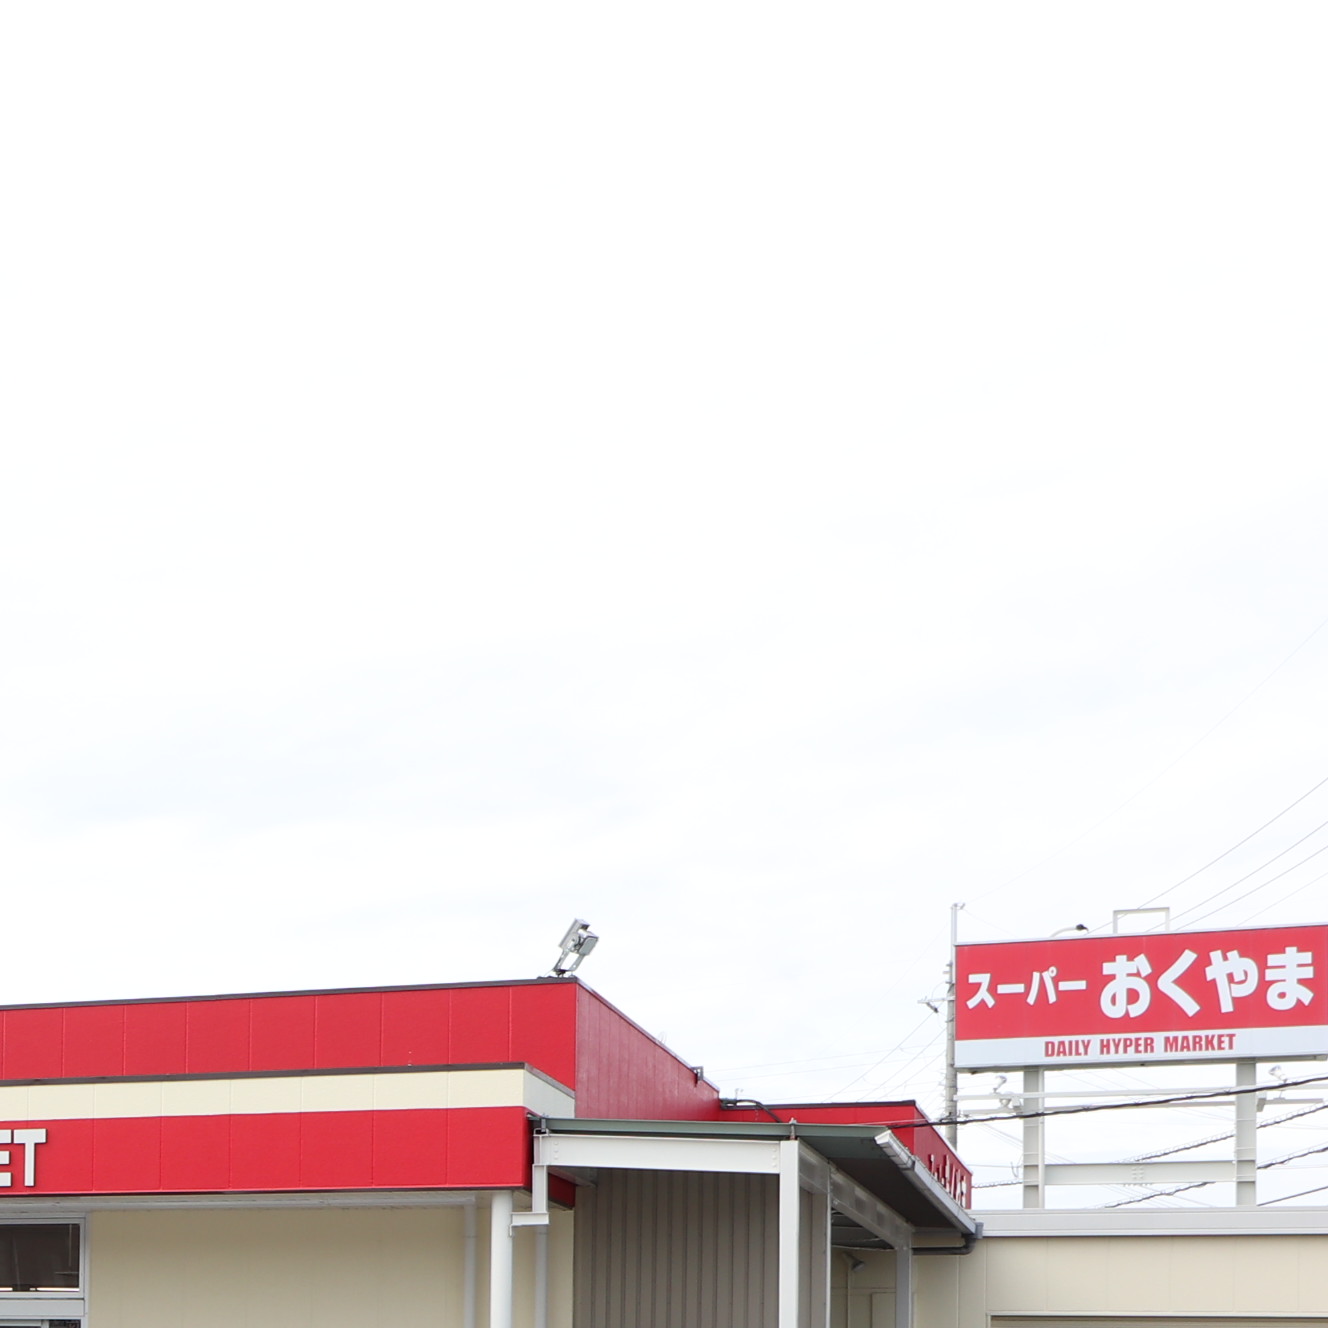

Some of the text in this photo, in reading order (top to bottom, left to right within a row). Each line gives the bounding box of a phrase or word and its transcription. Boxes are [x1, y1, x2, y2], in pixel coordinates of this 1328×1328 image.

[965, 945, 1315, 1019] スーパーおくやま
[1044, 1033, 1237, 1058] DAILY HYPER MARKET
